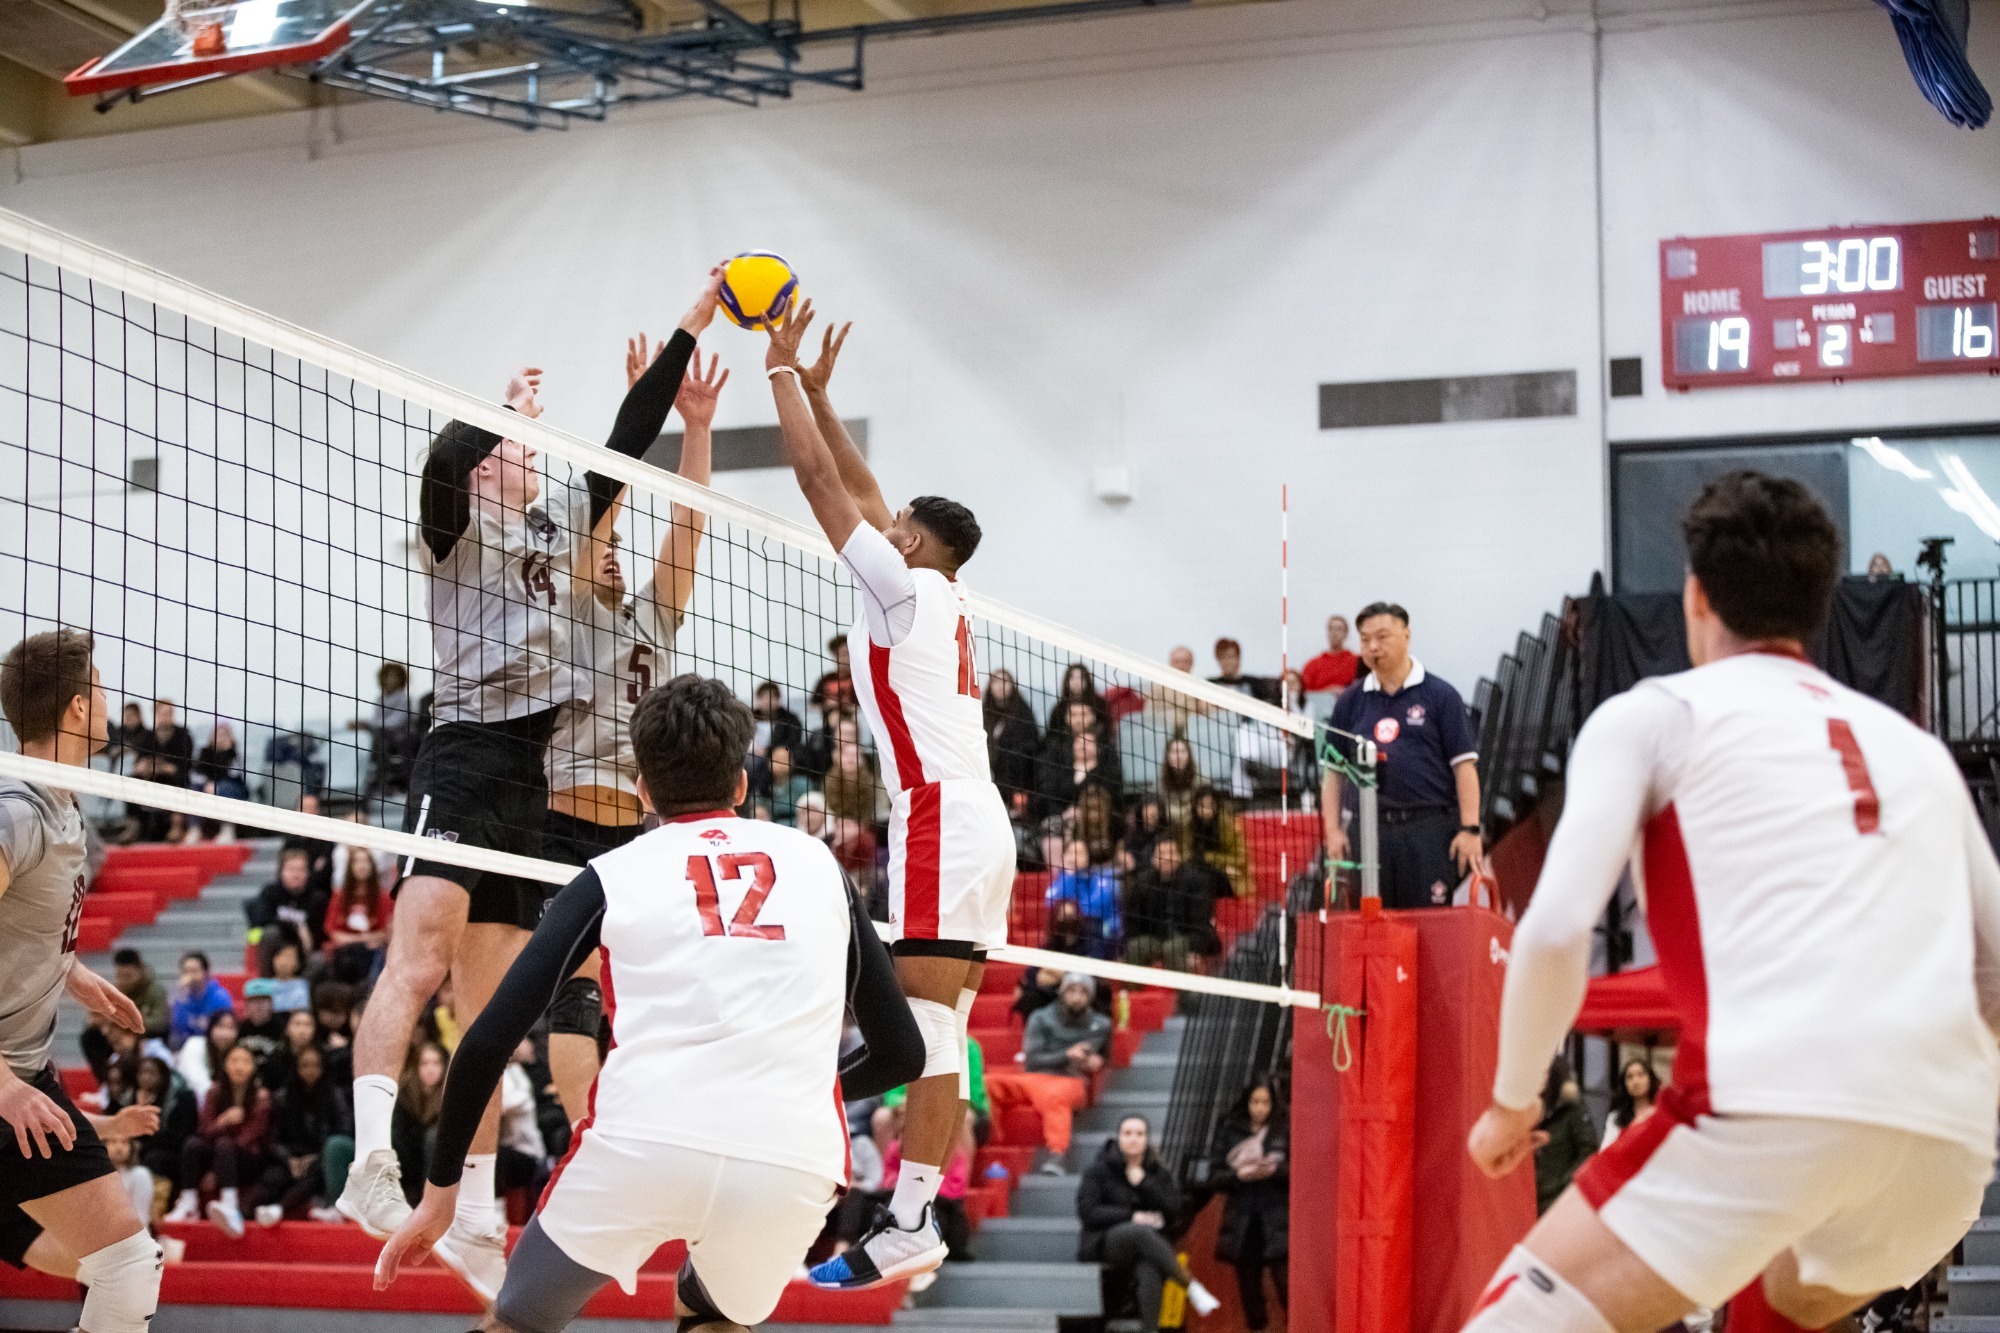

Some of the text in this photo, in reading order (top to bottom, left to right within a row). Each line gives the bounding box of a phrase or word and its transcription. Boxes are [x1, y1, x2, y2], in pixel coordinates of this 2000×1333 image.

[1800, 236, 1899, 295] 3:00
[1923, 273, 1987, 301] GUEST
[1683, 287, 1741, 314] HOME
[1708, 317, 1750, 371] 19
[1822, 324, 1848, 366] 2
[1953, 306, 1993, 358] 16
[626, 643, 654, 704] 5
[1826, 717, 1881, 835] 1
[685, 851, 787, 941] 12
